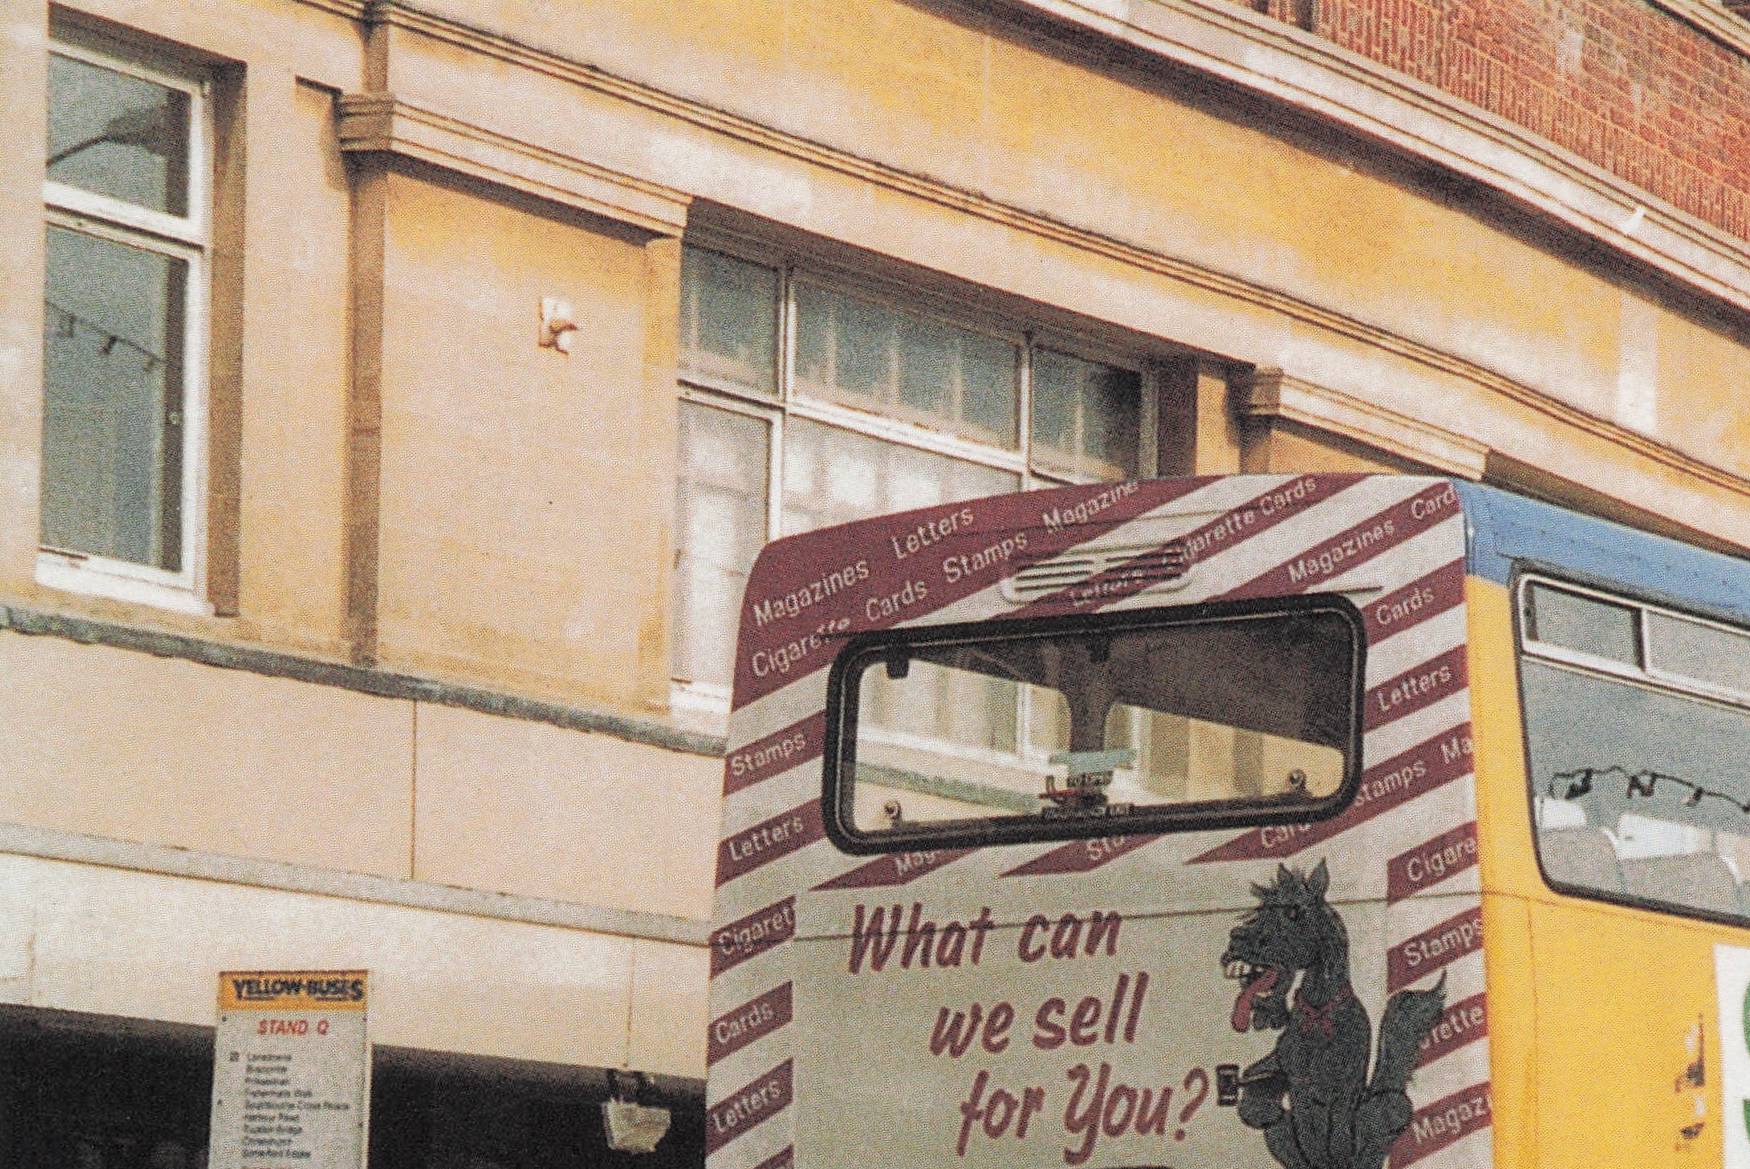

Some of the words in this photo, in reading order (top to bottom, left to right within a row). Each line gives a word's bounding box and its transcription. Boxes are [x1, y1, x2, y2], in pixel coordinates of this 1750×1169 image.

[1260, 476, 1316, 516] Cards
[753, 559, 870, 626] Magazines
[891, 507, 974, 559] Letters
[866, 579, 928, 621] Cards
[942, 531, 1028, 583] Stamps
[1288, 519, 1395, 584] Magazines
[1376, 586, 1435, 625] Cards
[1377, 665, 1452, 712] Letters
[730, 733, 806, 776] Stamps
[729, 816, 804, 861] Letters
[849, 902, 995, 975] What
[1018, 910, 1123, 963] can
[257, 1019, 308, 1036] STAND
[716, 1003, 774, 1044] Cards
[930, 1001, 1015, 1059] we
[1031, 970, 1150, 1051] sell
[713, 1081, 780, 1133] Letters
[956, 1070, 1046, 1157] for
[1063, 1061, 1210, 1166] You?
